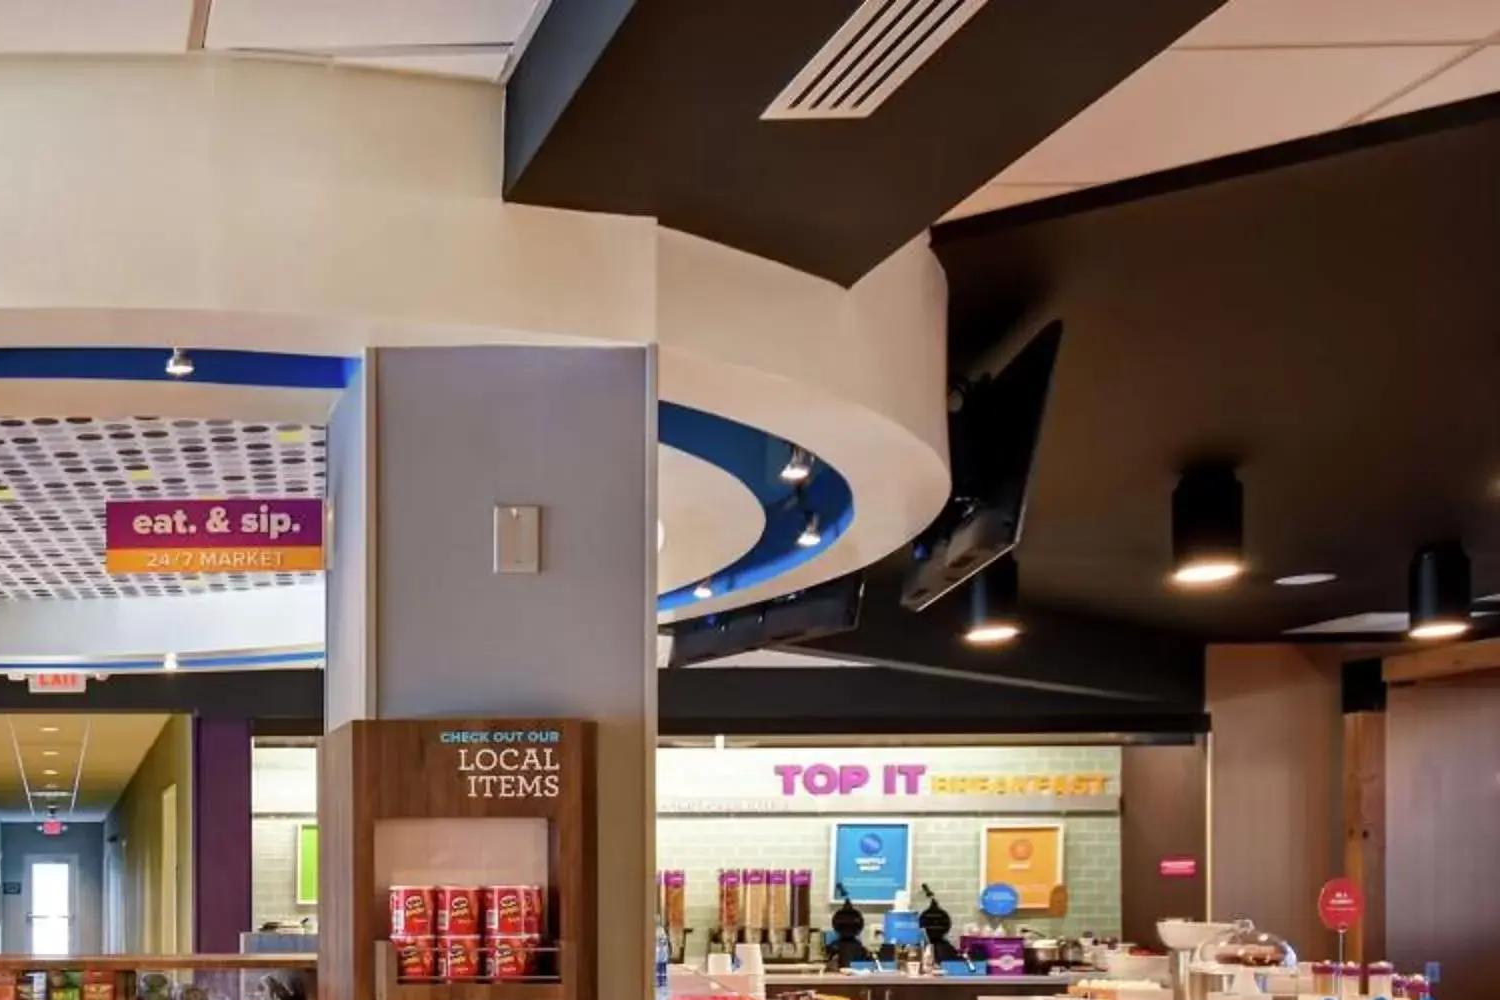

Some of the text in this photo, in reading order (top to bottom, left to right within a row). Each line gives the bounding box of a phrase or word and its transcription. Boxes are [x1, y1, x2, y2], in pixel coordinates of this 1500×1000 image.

[132, 504, 301, 539] eat. & sip.
[201, 551, 283, 567] MARKET
[440, 731, 560, 743] CHECK OUT OUR
[458, 748, 560, 771] LOCAL
[467, 775, 559, 797] ITEMS
[775, 763, 869, 795] TOP
[884, 764, 926, 794] IT
